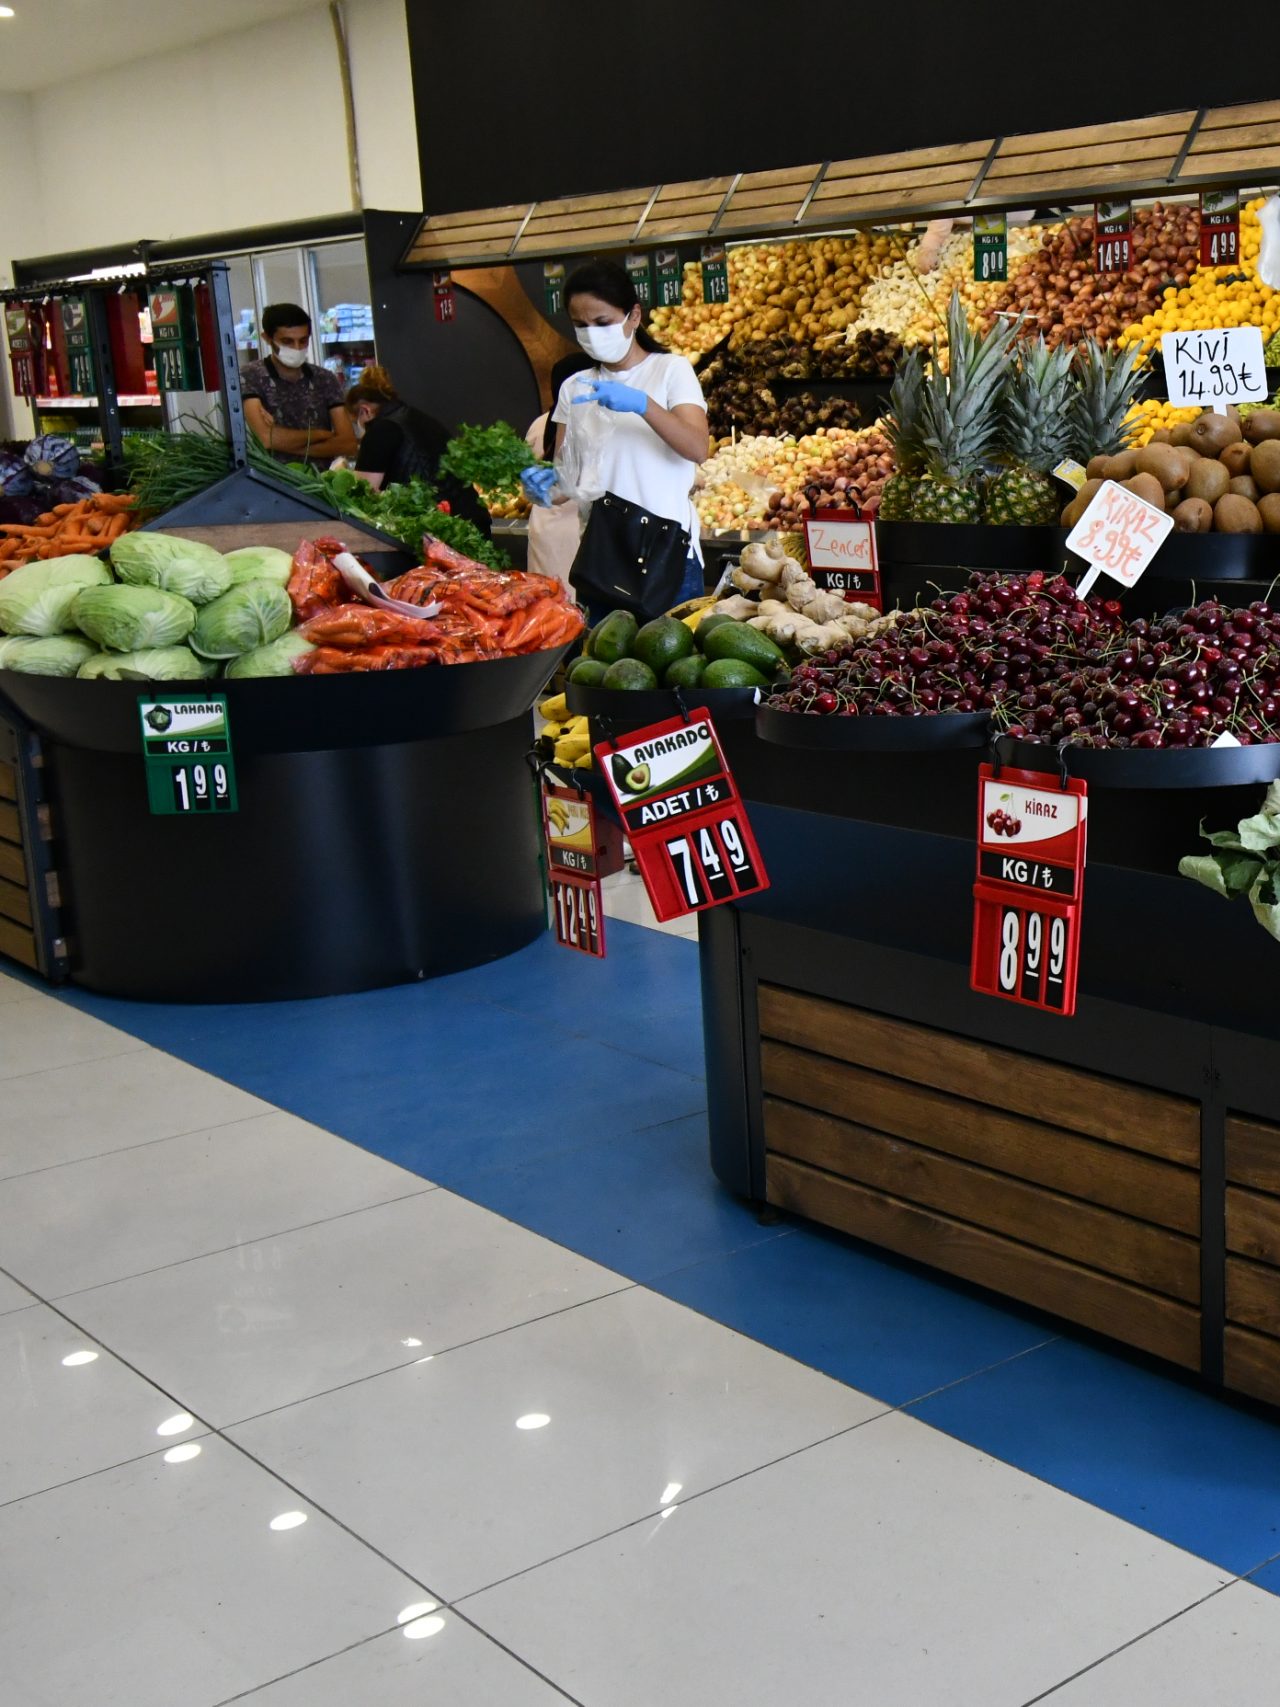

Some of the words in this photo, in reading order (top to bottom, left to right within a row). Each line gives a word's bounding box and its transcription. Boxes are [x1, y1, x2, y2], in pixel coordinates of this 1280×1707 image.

[1098, 240, 1129, 271] 1499
[1210, 231, 1236, 264] 499
[982, 251, 1003, 279] 800
[826, 572, 845, 588] KG
[174, 704, 223, 715] LAHANA
[167, 741, 190, 753] KG
[634, 725, 710, 763] AVAKADO
[175, 764, 227, 810] 199
[641, 792, 690, 825] ADET
[1025, 798, 1057, 819] KİRAZ
[562, 850, 575, 867] KG
[667, 820, 746, 905] 749
[1002, 858, 1028, 883] KG
[557, 885, 597, 943] 1249
[1000, 912, 1065, 991] 899
